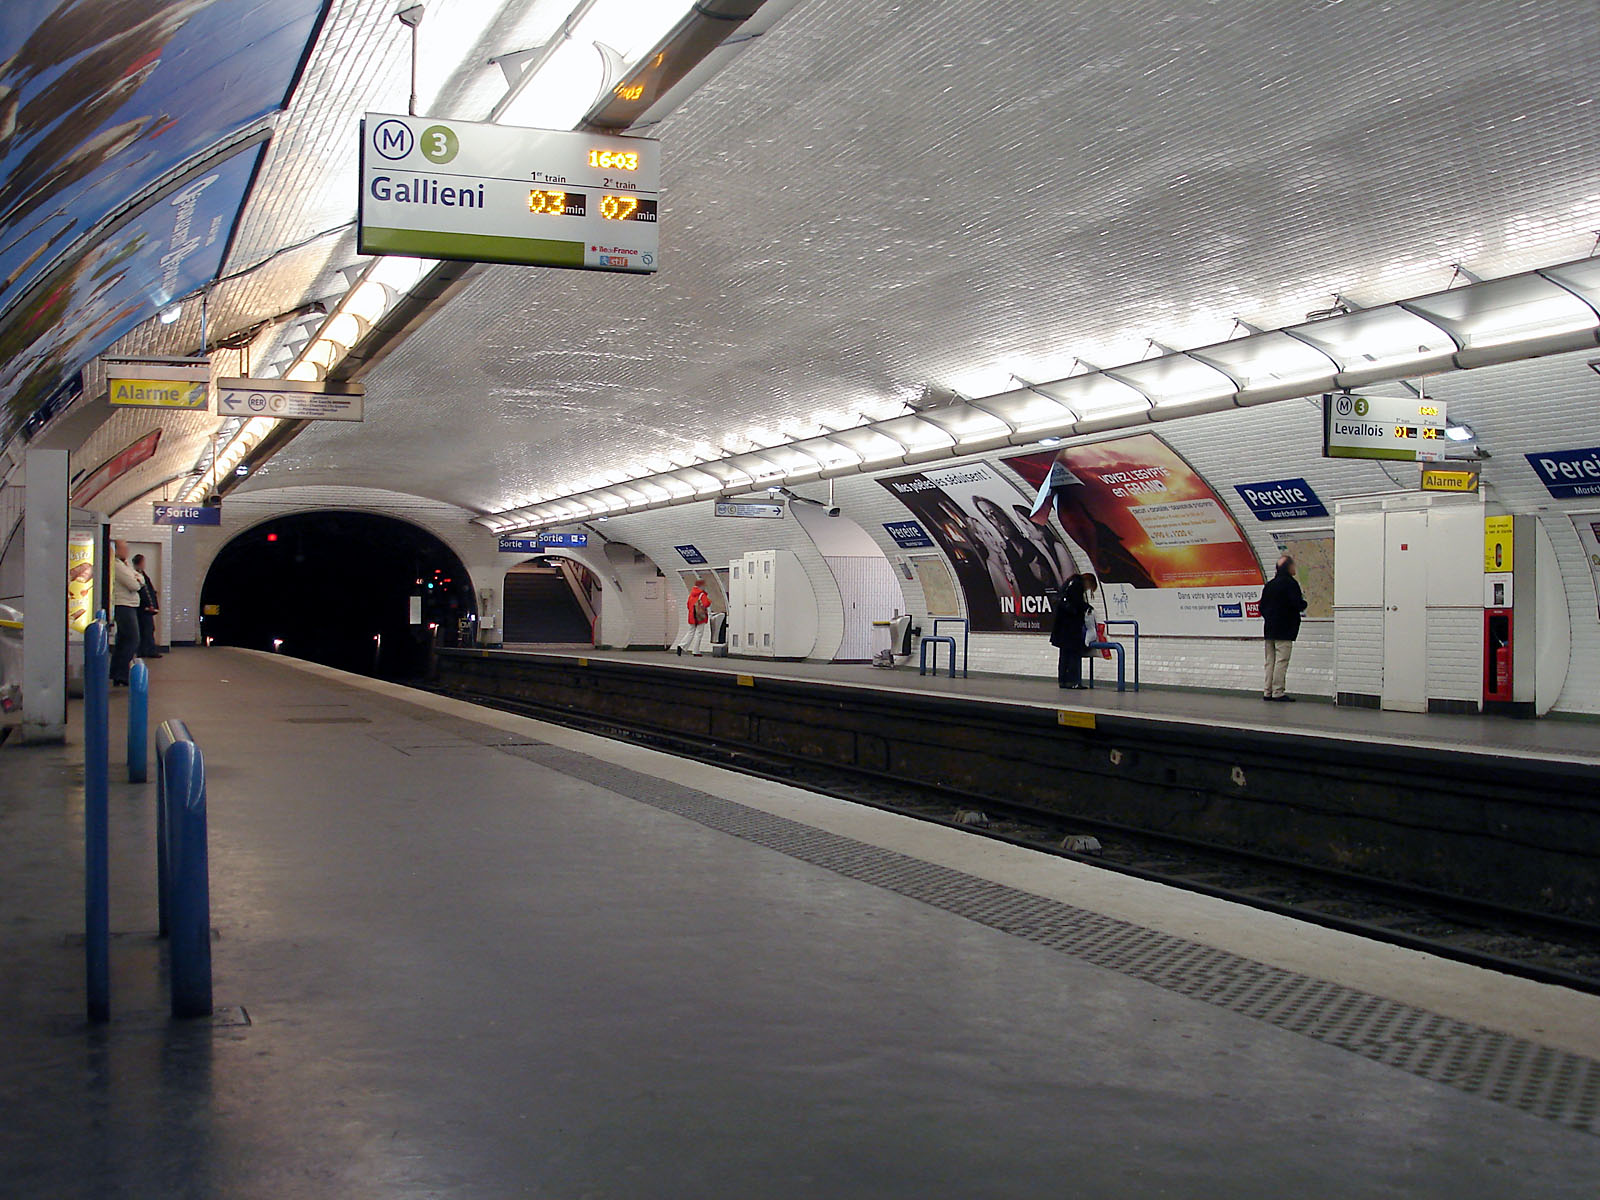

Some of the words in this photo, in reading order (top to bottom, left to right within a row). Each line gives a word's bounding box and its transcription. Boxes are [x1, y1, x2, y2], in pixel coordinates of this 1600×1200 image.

[431, 132, 448, 157] 3
[589, 151, 638, 171] 16:03
[545, 174, 566, 183] train
[370, 176, 484, 208] Gallieni
[616, 181, 637, 190] train
[528, 190, 565, 215] 03
[566, 205, 585, 215] min
[600, 196, 637, 220] 07
[637, 212, 656, 221] min
[116, 384, 180, 401] Alarme
[250, 398, 264, 406] RER
[1357, 402, 1365, 412] 3
[1335, 422, 1384, 437] Levallois
[1394, 426, 1408, 438] 01
[1423, 427, 1437, 440] 04
[1097, 472, 1131, 485] VOYEZ
[1426, 476, 1463, 487] Alarme
[892, 482, 913, 493] Mes
[1112, 487, 1130, 498] en
[1124, 479, 1168, 496] GRAND
[1244, 485, 1308, 506] Pereire
[167, 507, 200, 518] Sortie
[888, 524, 921, 538] Pereire
[500, 540, 522, 548] Sortie
[1177, 591, 1190, 600] Dans
[1192, 592, 1205, 600] votre
[1206, 592, 1224, 601] agence
[1226, 590, 1233, 599] de
[1234, 591, 1258, 601] voyages
[1000, 595, 1052, 616] INVICTA
